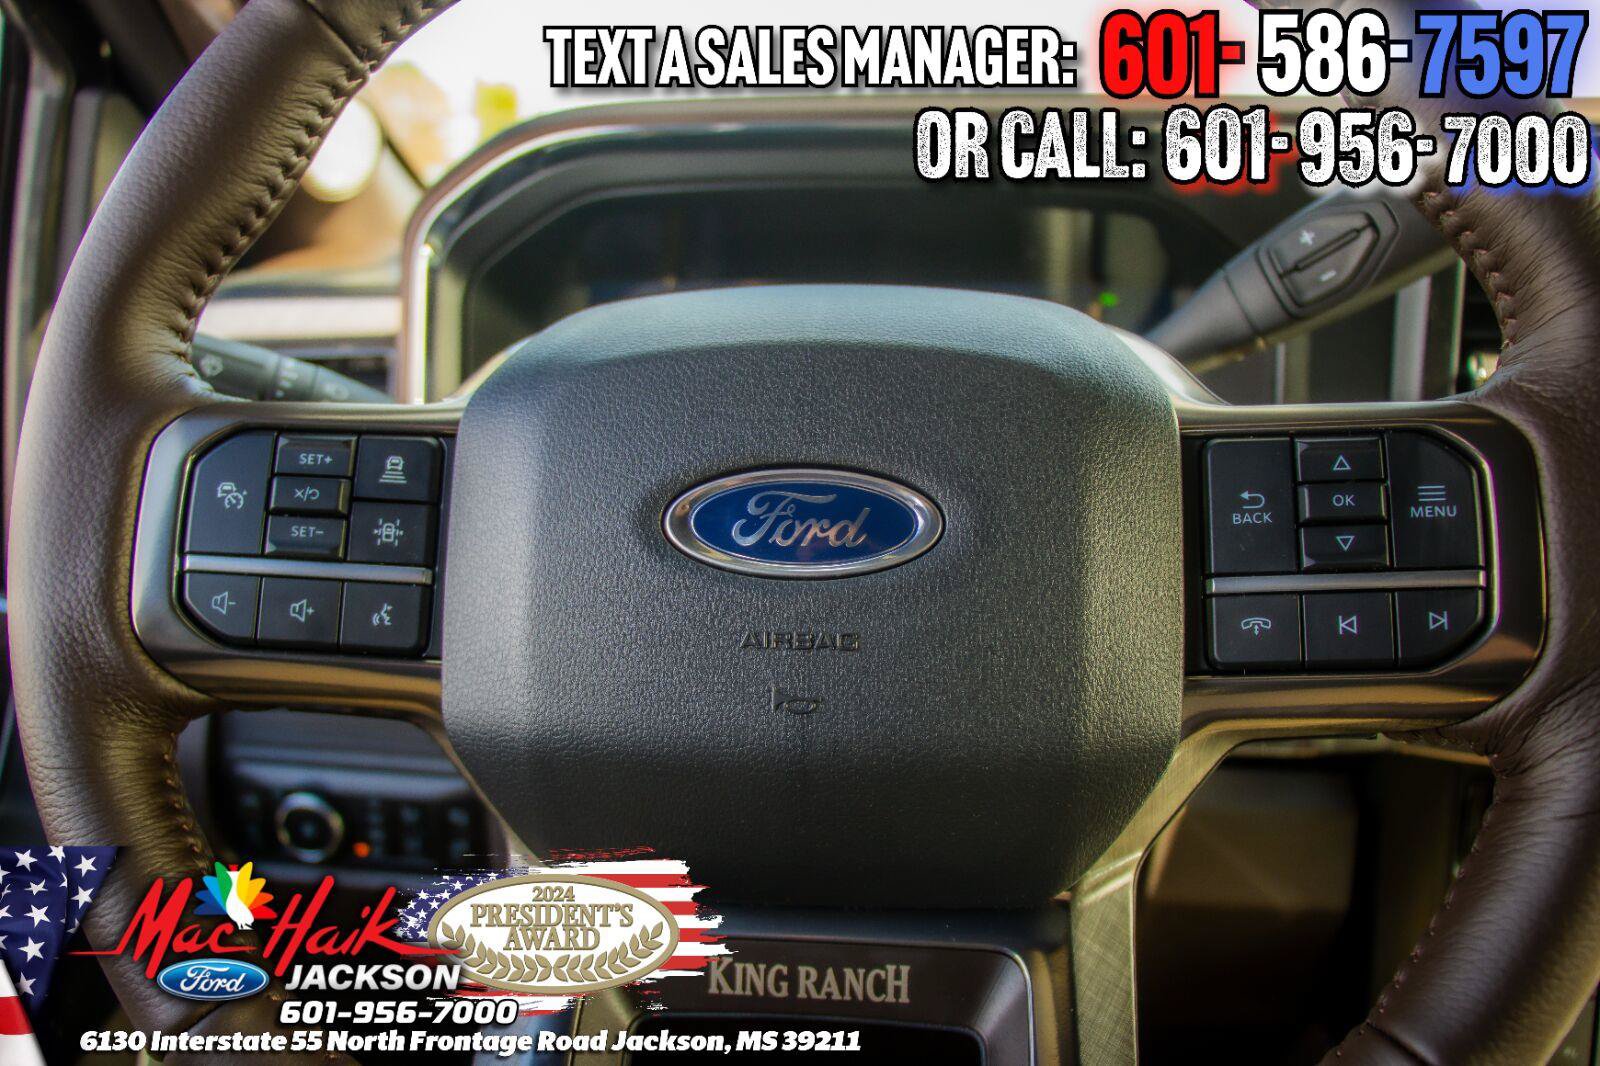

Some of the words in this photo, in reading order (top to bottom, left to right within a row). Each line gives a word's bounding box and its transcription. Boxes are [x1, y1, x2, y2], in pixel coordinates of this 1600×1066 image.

[299, 453, 333, 465] SET+
[1332, 494, 1355, 507] OK
[1410, 505, 1457, 518] MENU
[732, 490, 871, 548] Ford
[1232, 512, 1273, 525] BACK
[740, 629, 861, 651] AIRBAG
[708, 956, 788, 998] KING
[799, 965, 911, 1004] RANCH
